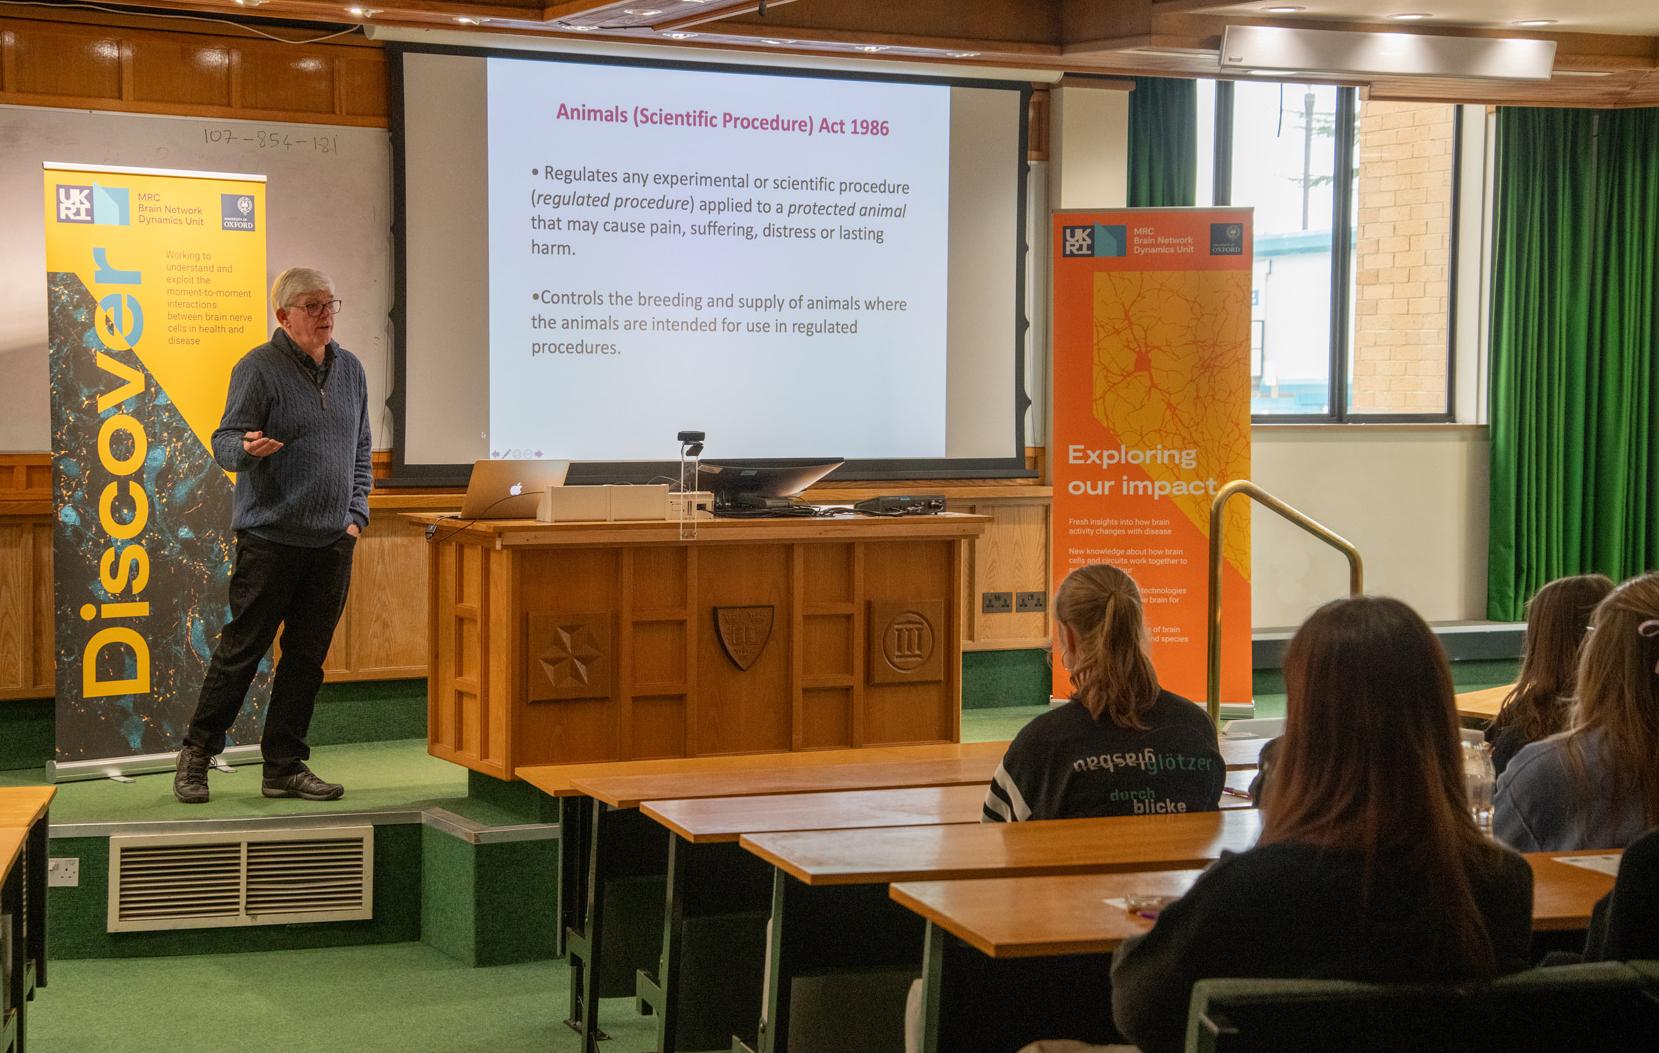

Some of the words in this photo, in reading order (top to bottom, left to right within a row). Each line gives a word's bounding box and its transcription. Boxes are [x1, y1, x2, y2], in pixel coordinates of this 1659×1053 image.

[556, 103, 628, 123] Animals
[633, 106, 718, 128] (Scientific
[722, 112, 814, 136] Procedure)
[819, 118, 846, 134] Act
[850, 119, 889, 136] 1986
[544, 165, 618, 184] Regulates
[623, 171, 649, 187] any
[653, 172, 749, 188] experimental
[754, 177, 769, 189] or
[773, 176, 835, 191] scientific
[839, 179, 910, 195] procedure
[138, 193, 160, 202] MRC
[531, 189, 611, 208] (regulated
[614, 195, 695, 213] procedure)
[699, 198, 752, 214] applied
[757, 200, 771, 213] to
[776, 203, 784, 213] a
[787, 202, 856, 217] protected
[859, 204, 907, 218] animal
[138, 204, 162, 213] Brain
[165, 205, 202, 215] Network
[138, 215, 182, 225] Dynamics
[185, 217, 204, 226] Unit
[224, 221, 253, 229] OXFORD
[531, 214, 566, 230] that
[567, 219, 598, 235] may
[603, 221, 645, 233] cause
[650, 220, 686, 237] pain,
[690, 221, 758, 240] suffering,
[762, 223, 816, 238] distress
[820, 227, 835, 239] or
[840, 225, 884, 244] lasting
[532, 239, 576, 255] harm.
[1134, 246, 1174, 254] Dynamics
[166, 250, 199, 262] Working
[202, 252, 212, 260] to
[166, 263, 214, 273] understand
[217, 264, 233, 273] and
[167, 275, 194, 285] exploit
[196, 276, 211, 285] the
[167, 288, 252, 298] moment-to-moment
[168, 300, 217, 309] interactions
[608, 291, 633, 306] the
[638, 292, 702, 311] breeding
[707, 293, 734, 308] and
[738, 294, 785, 312] supply
[789, 295, 804, 309] of
[807, 296, 860, 310] animals
[865, 296, 907, 311] where
[168, 312, 203, 321] between
[205, 313, 227, 321] brain
[168, 324, 187, 333] cells
[189, 325, 196, 333] in
[199, 325, 226, 333] health
[228, 325, 244, 334] and
[531, 314, 556, 329] the
[561, 315, 619, 330] animals
[624, 319, 647, 331] are
[652, 317, 717, 332] intended
[721, 317, 741, 332] for
[746, 321, 770, 333] use
[775, 319, 787, 333] in
[792, 319, 858, 336] regulated
[168, 336, 200, 345] disease
[532, 339, 621, 357] procedures.
[1068, 444, 1198, 469] Exploring
[80, 247, 150, 698] Discover
[1068, 479, 1115, 495] our
[1122, 475, 1217, 500] impact
[1068, 518, 1088, 526] Fresh
[1091, 518, 1118, 527] insights
[1120, 518, 1133, 526] into
[1135, 518, 1150, 526] how
[1152, 518, 1170, 526] brain
[1068, 528, 1094, 536] activity
[1096, 528, 1126, 536] changes
[1086, 548, 1124, 556] knowledge
[1087, 557, 1100, 565] and
[1102, 557, 1128, 565] circuits
[1129, 557, 1147, 565] work
[1148, 557, 1179, 566] together
[1161, 636, 1189, 644] species
[1146, 753, 1212, 775] glötzer
[1110, 787, 1156, 801] durch
[1133, 798, 1187, 814] blicke
